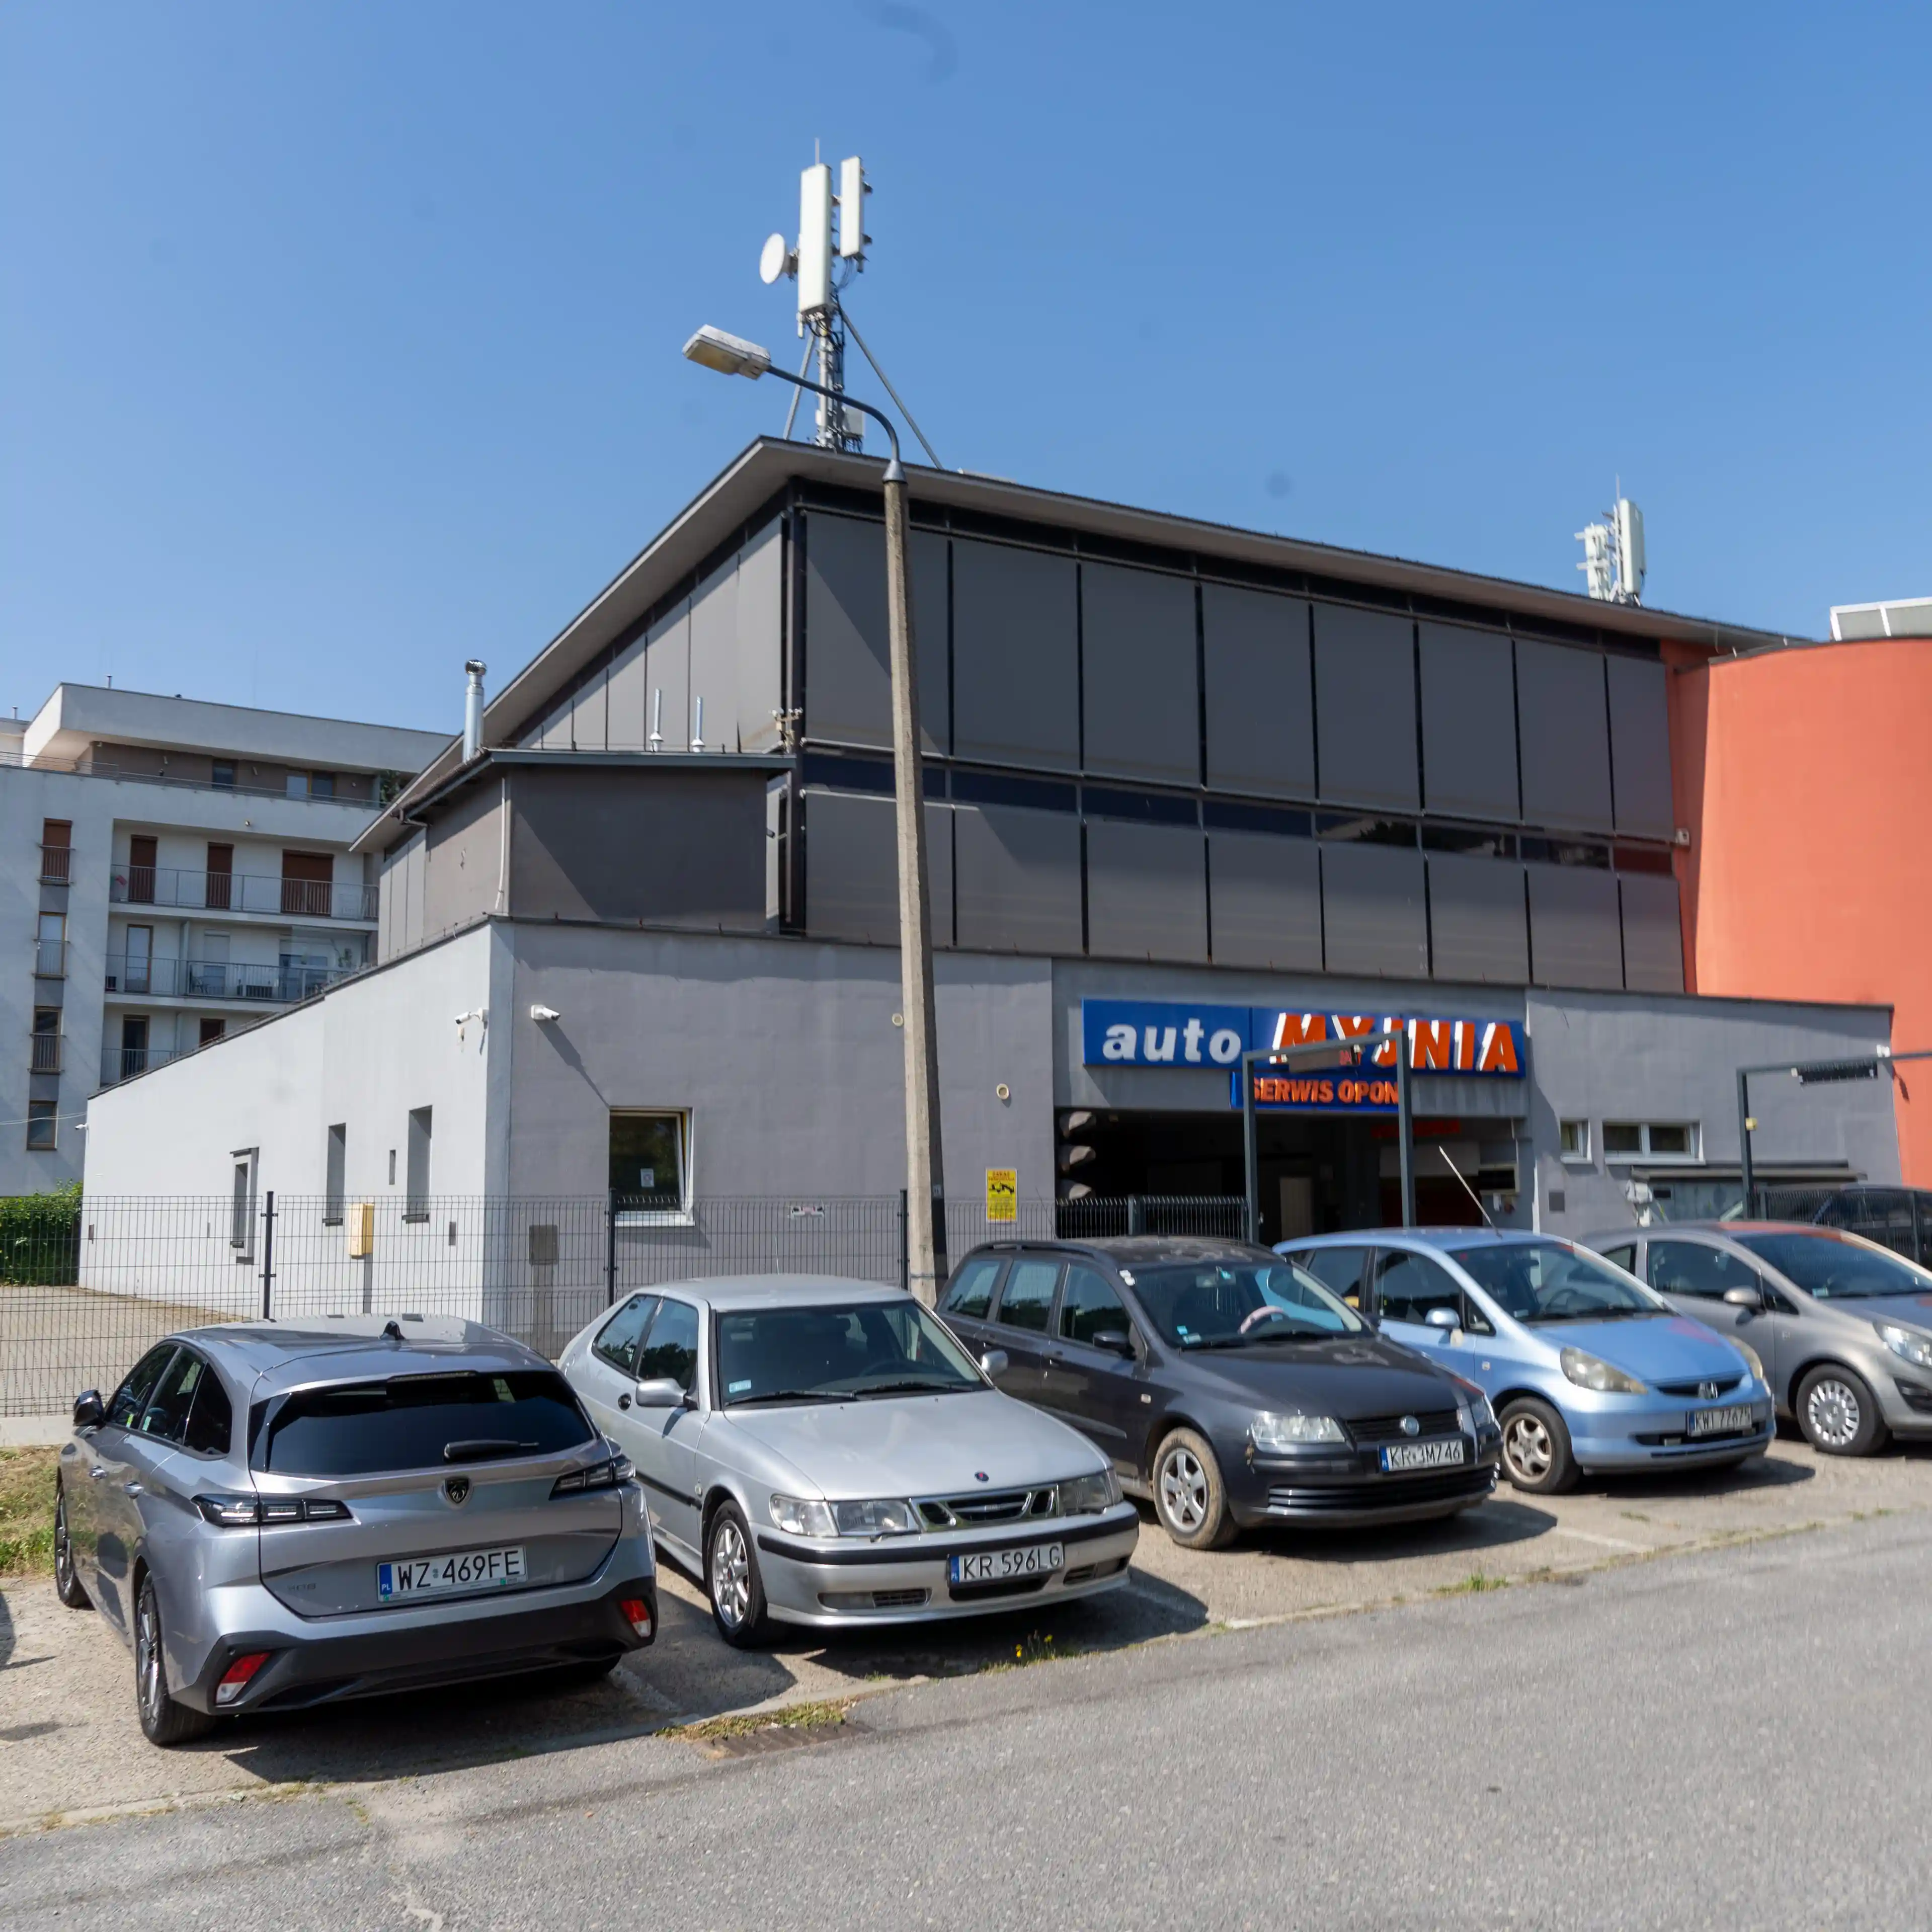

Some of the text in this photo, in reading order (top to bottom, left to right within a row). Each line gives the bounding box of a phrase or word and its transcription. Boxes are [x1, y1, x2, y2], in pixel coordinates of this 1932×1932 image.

[1102, 1017, 1241, 1064] auto
[1254, 1077, 1399, 1104] SERWIS OPON
[397, 1550, 520, 1591] WZ 469FE
[963, 1555, 993, 1580] KR
[381, 1583, 391, 1591] PL
